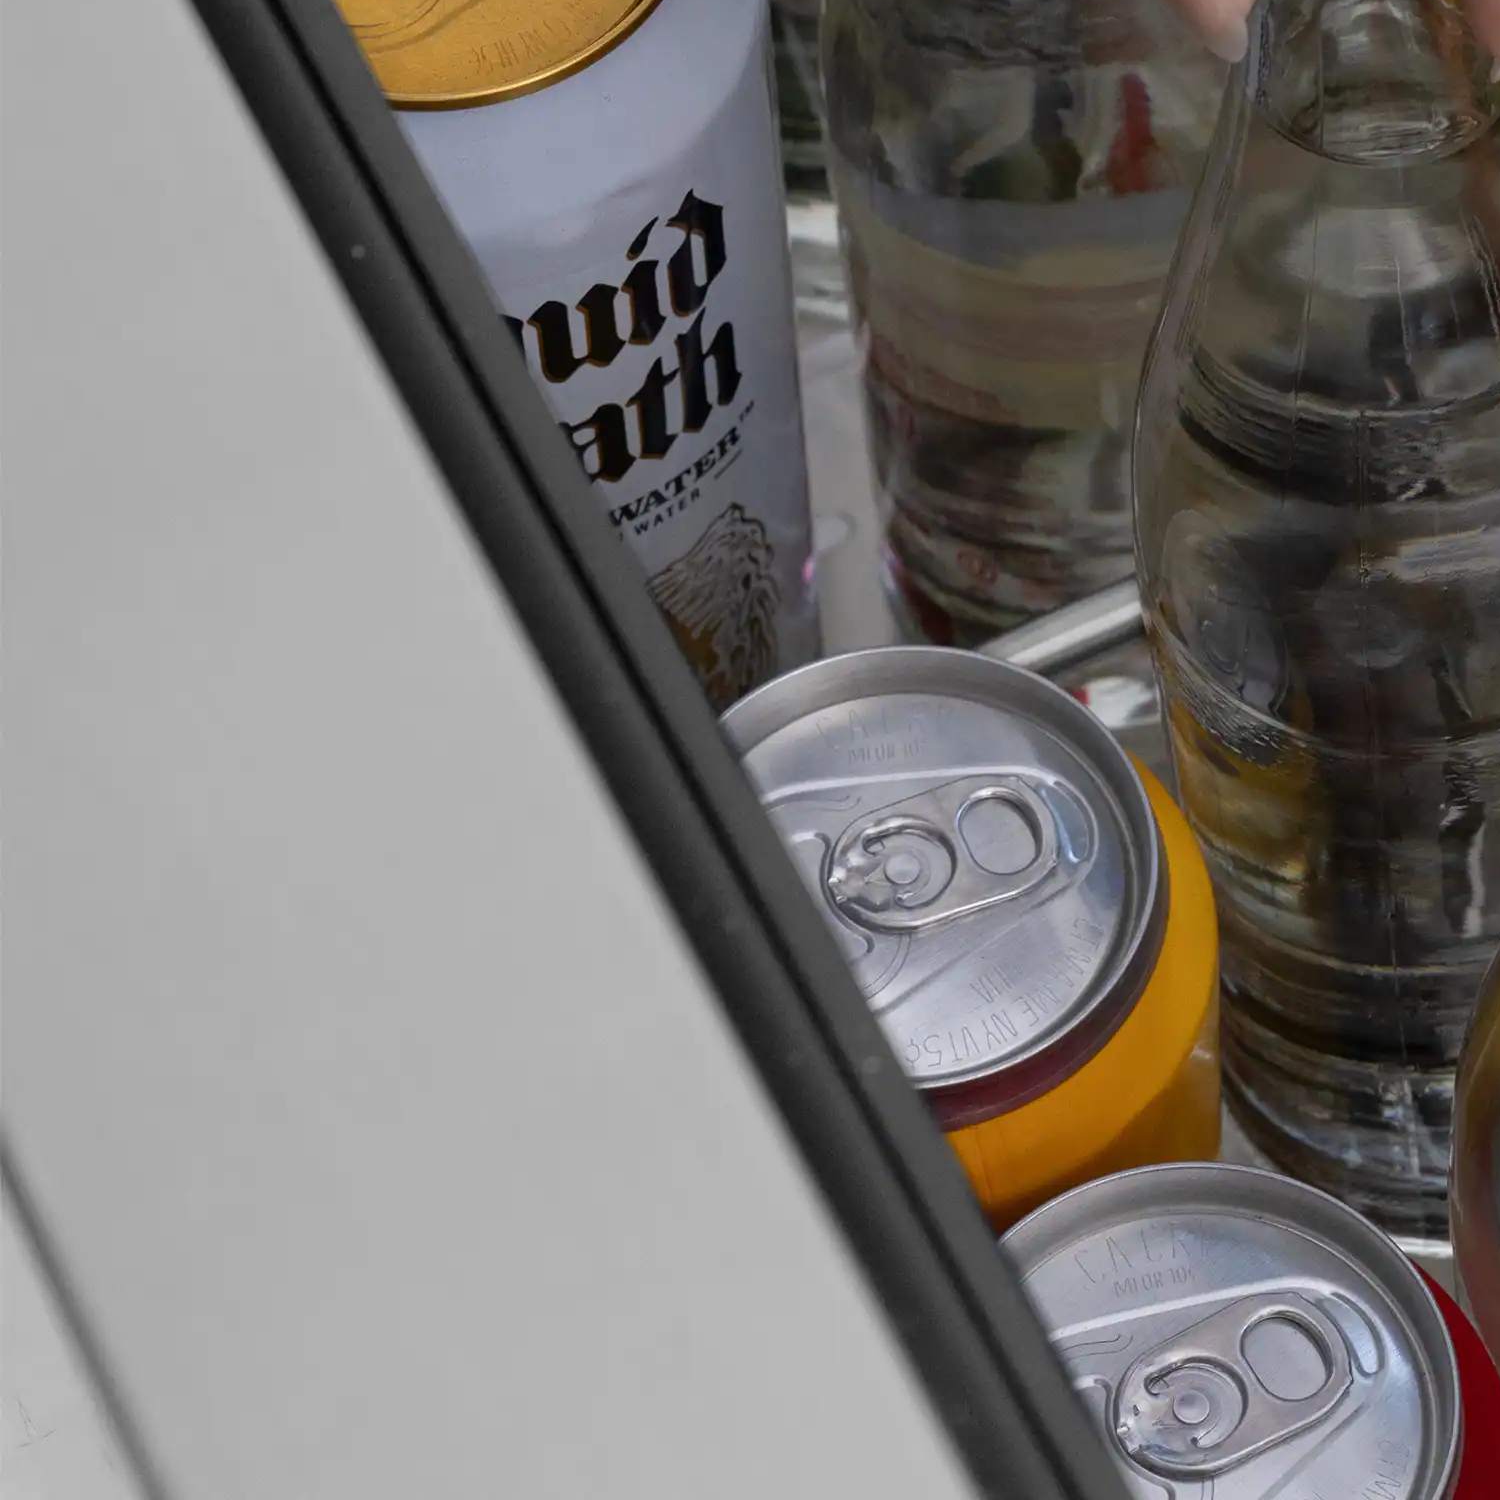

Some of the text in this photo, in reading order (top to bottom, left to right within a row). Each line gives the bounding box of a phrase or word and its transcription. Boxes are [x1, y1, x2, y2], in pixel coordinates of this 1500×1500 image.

[633, 487, 701, 536] WATER
[948, 1024, 981, 1064] VT
[979, 1008, 1019, 1051] NY
